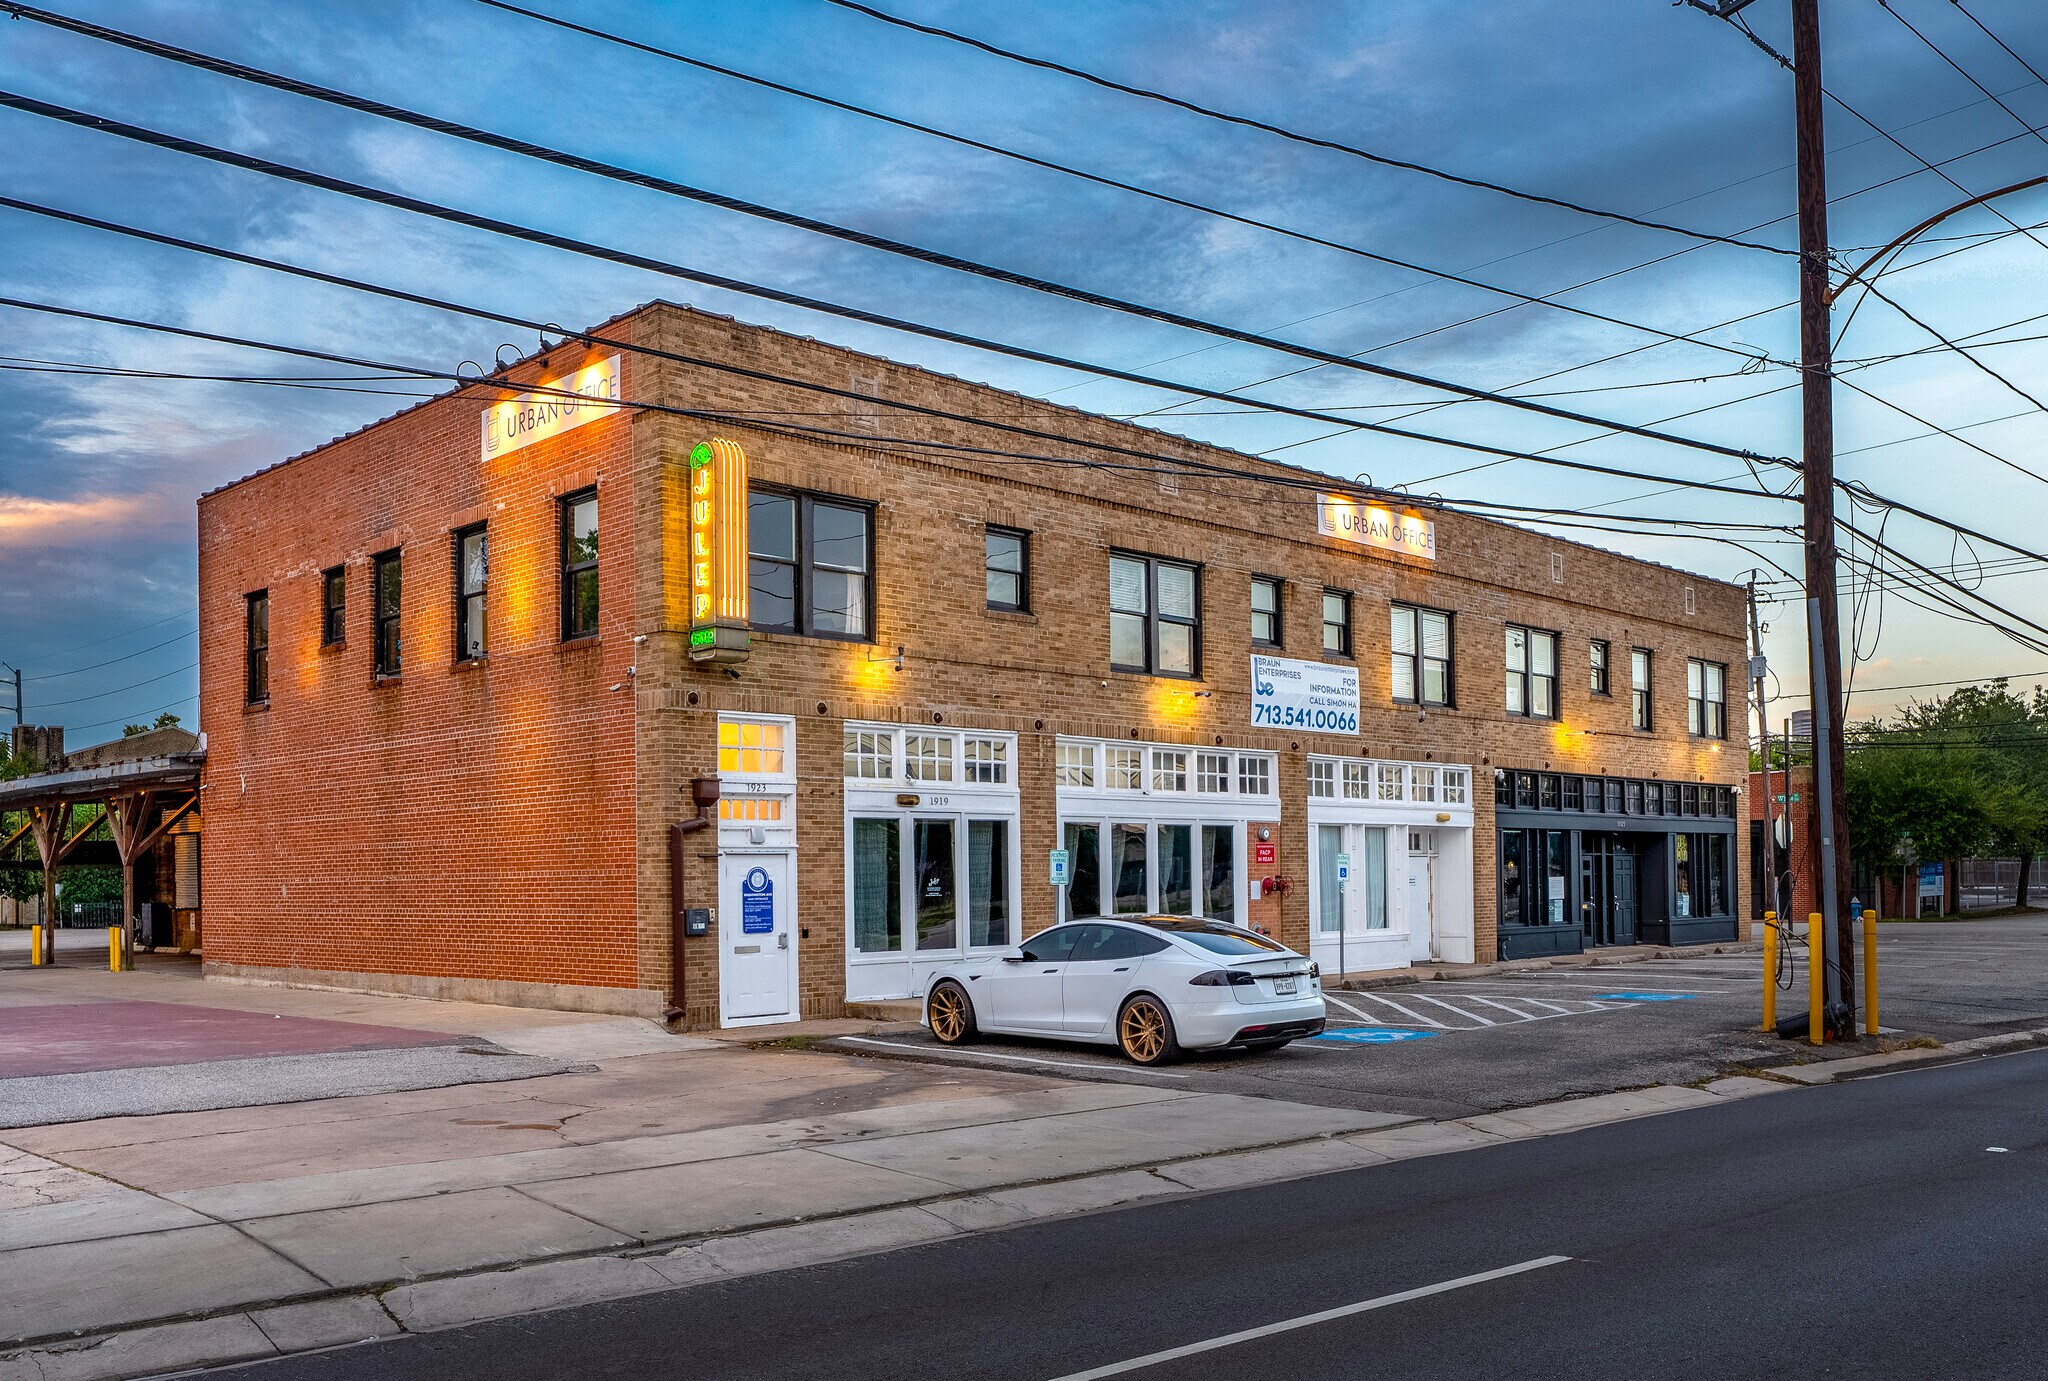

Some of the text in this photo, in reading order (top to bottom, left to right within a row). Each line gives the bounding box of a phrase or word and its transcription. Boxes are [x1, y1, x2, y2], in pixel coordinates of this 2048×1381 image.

[507, 374, 617, 438] URBAN OFFICE
[1342, 513, 1433, 549] URBAN OFFICE
[693, 469, 711, 619] JULEP
[1258, 657, 1281, 668] BRAUN
[1258, 667, 1302, 680] ENTERPRISES
[1342, 677, 1357, 688] FOR
[1309, 683, 1357, 697] INFORMATION
[1309, 696, 1357, 709] CALL SIMON HA
[1254, 703, 1357, 731] 713.541.0066
[746, 782, 767, 793] 1923
[930, 796, 949, 806] 1919
